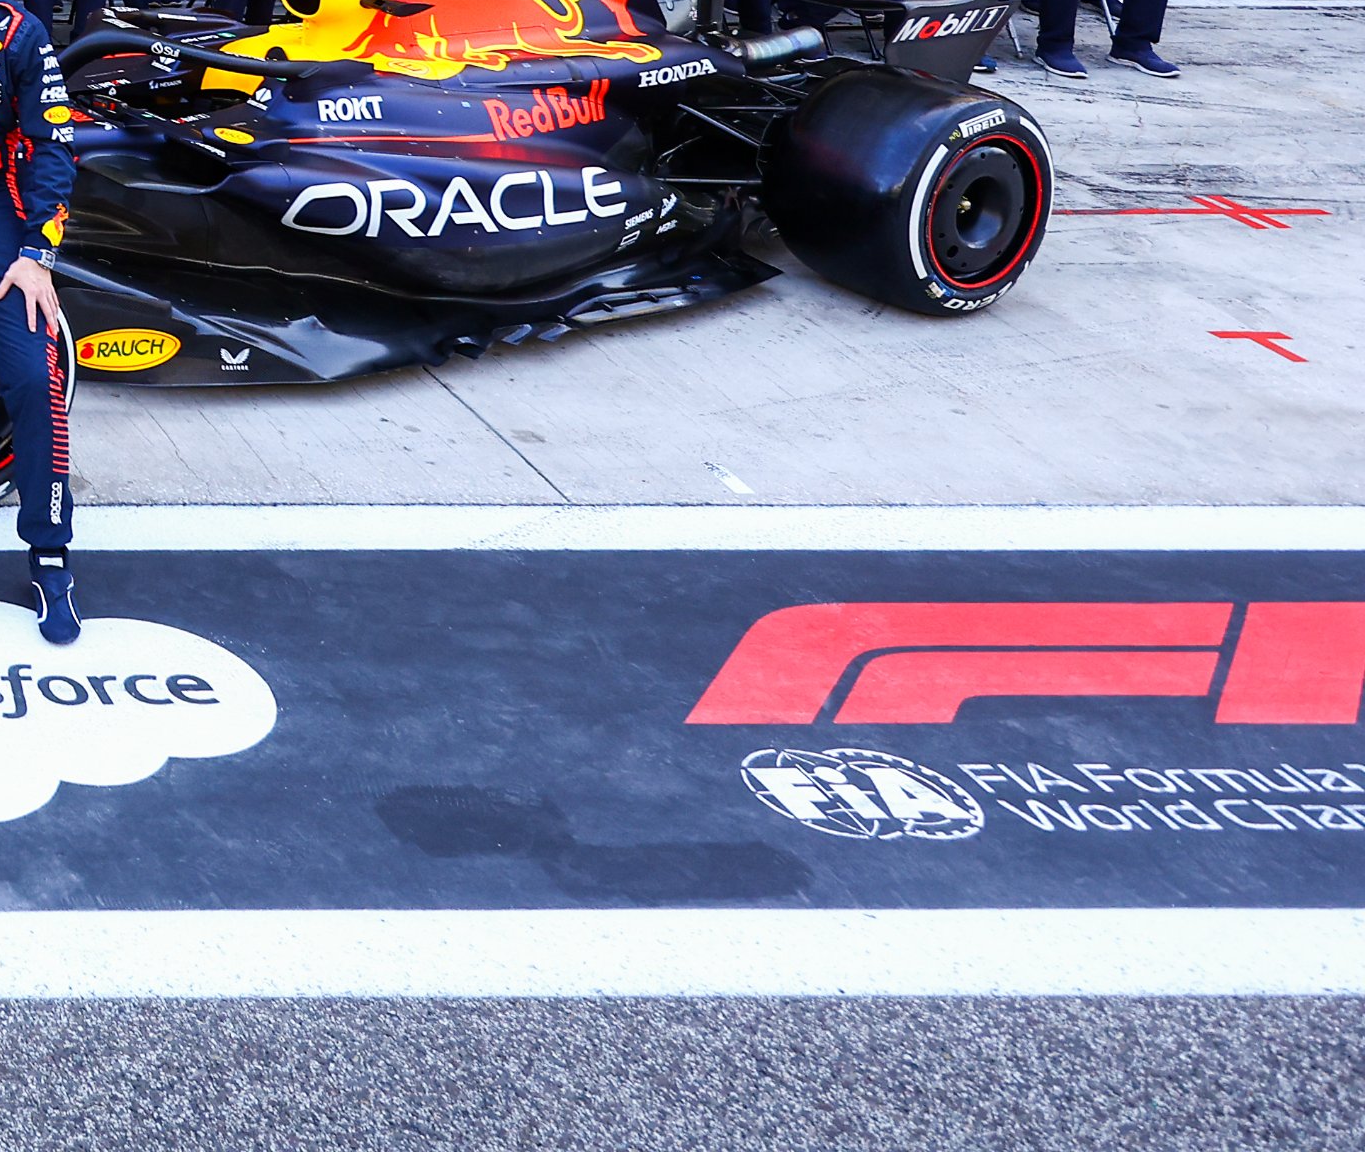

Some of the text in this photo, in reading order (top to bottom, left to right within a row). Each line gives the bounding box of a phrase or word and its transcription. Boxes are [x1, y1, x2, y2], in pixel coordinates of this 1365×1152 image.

[891, 10, 978, 44] Mobil
[638, 58, 717, 88] HONDA
[317, 94, 383, 124] ROKT
[958, 108, 1006, 138] PIRELLI
[282, 166, 627, 239] ORACLE
[95, 338, 166, 359] RAUCH
[50, 481, 63, 526] sparco
[958, 762, 1364, 794] FIA Formula
[997, 799, 1222, 833] World
